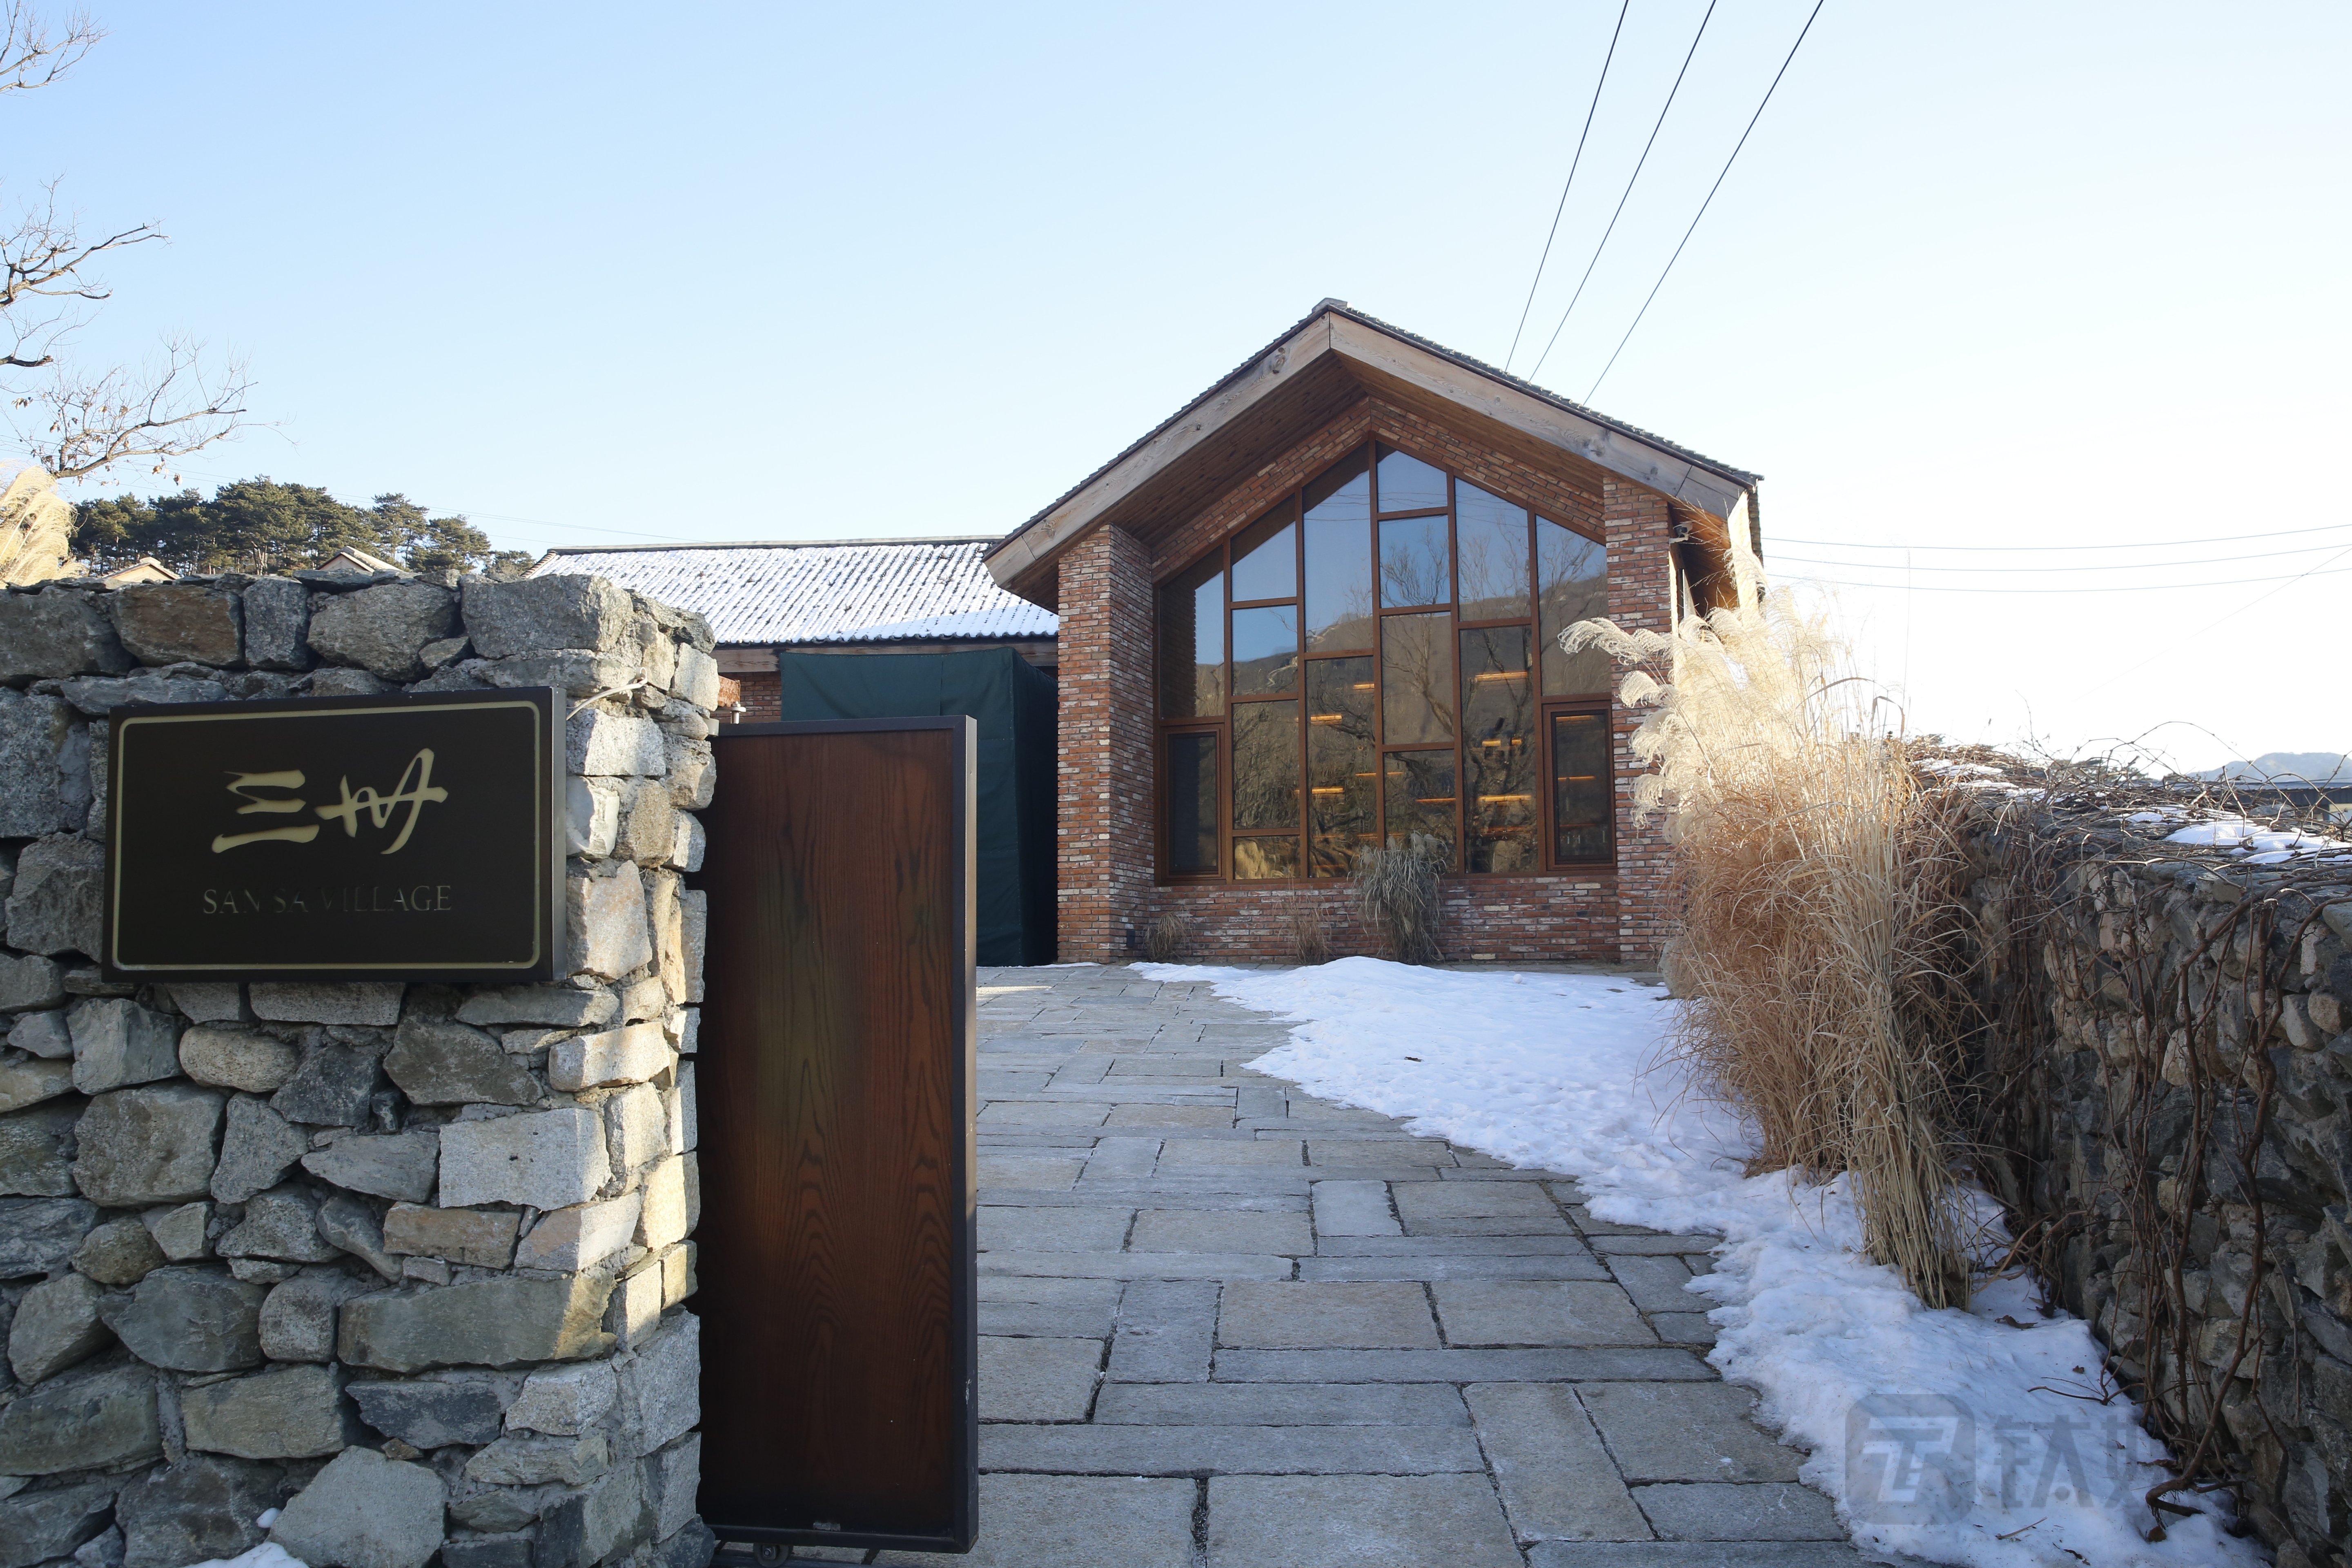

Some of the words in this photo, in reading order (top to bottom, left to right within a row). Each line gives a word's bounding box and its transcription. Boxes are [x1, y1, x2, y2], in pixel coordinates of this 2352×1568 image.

[203, 888, 261, 914] SAN
[272, 887, 310, 913] SA
[317, 885, 452, 912] VILLAGE
